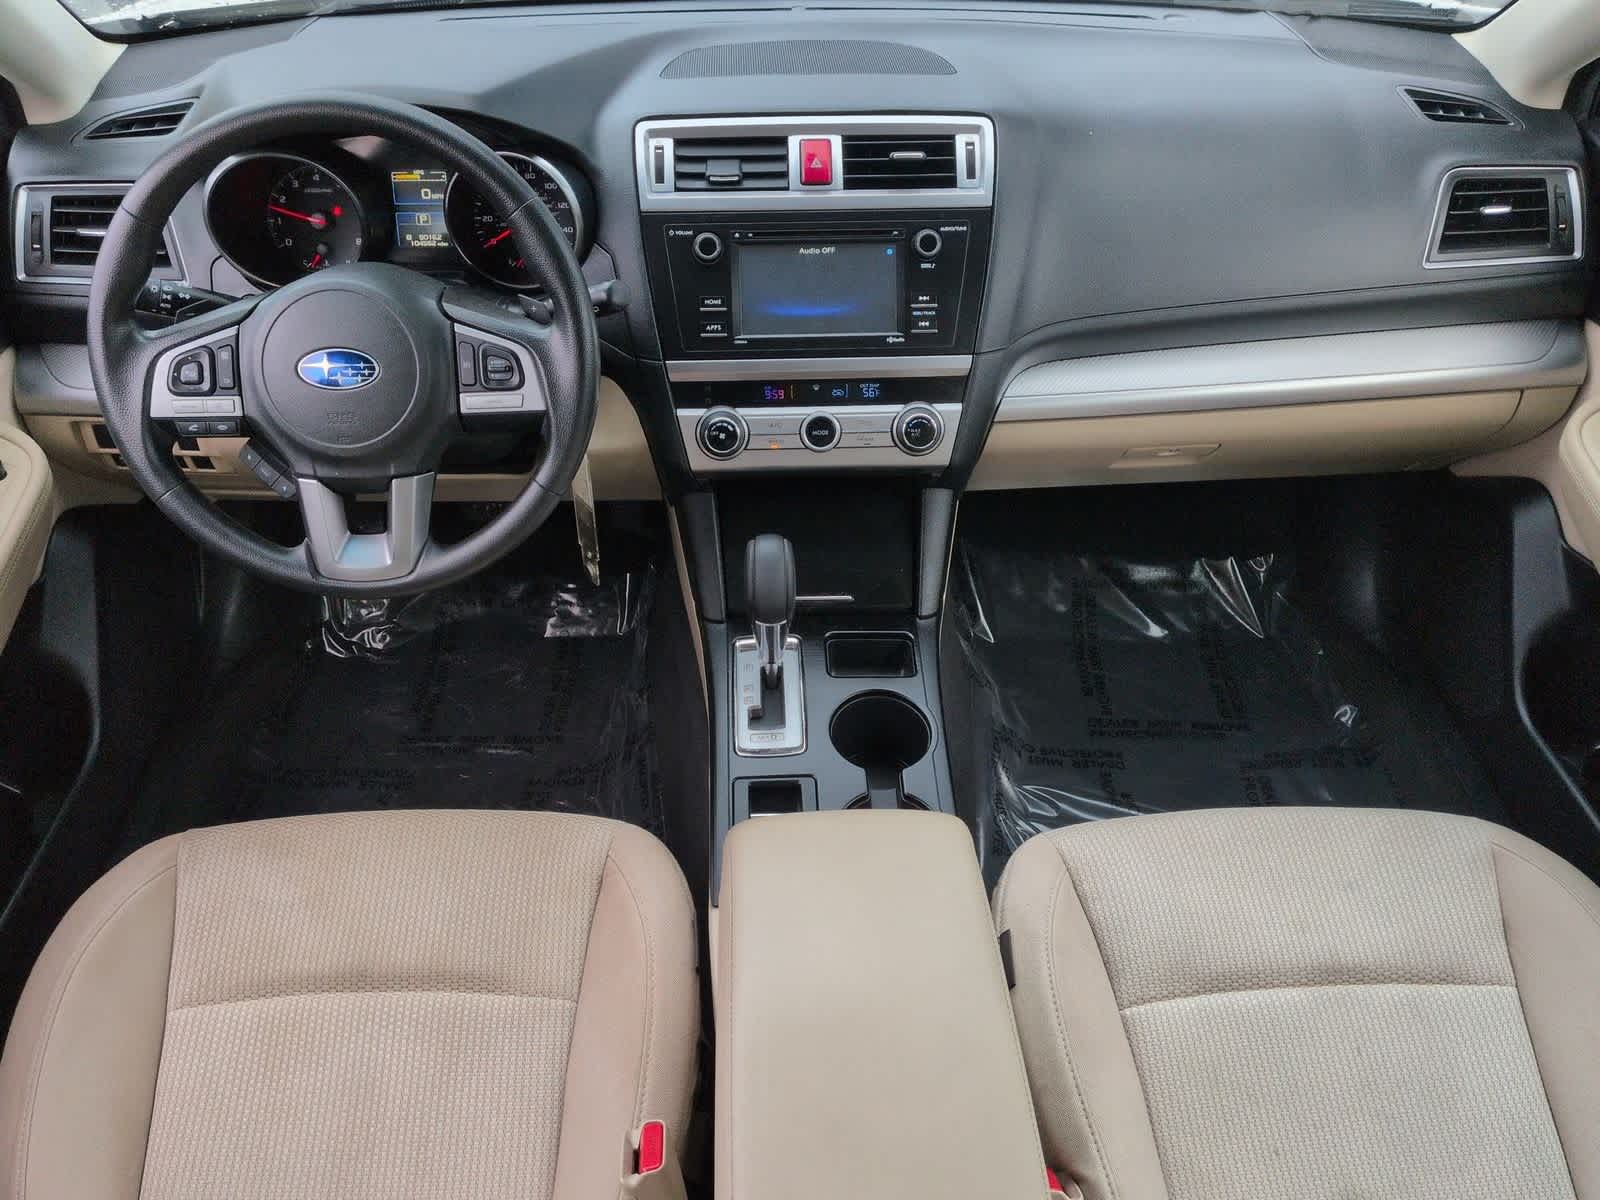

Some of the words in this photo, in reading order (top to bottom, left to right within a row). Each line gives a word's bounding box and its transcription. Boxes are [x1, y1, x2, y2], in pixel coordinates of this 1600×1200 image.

[482, 215, 493, 223] 20
[799, 247, 821, 255] Audio
[821, 246, 835, 254] OFF
[705, 324, 722, 332] APPS
